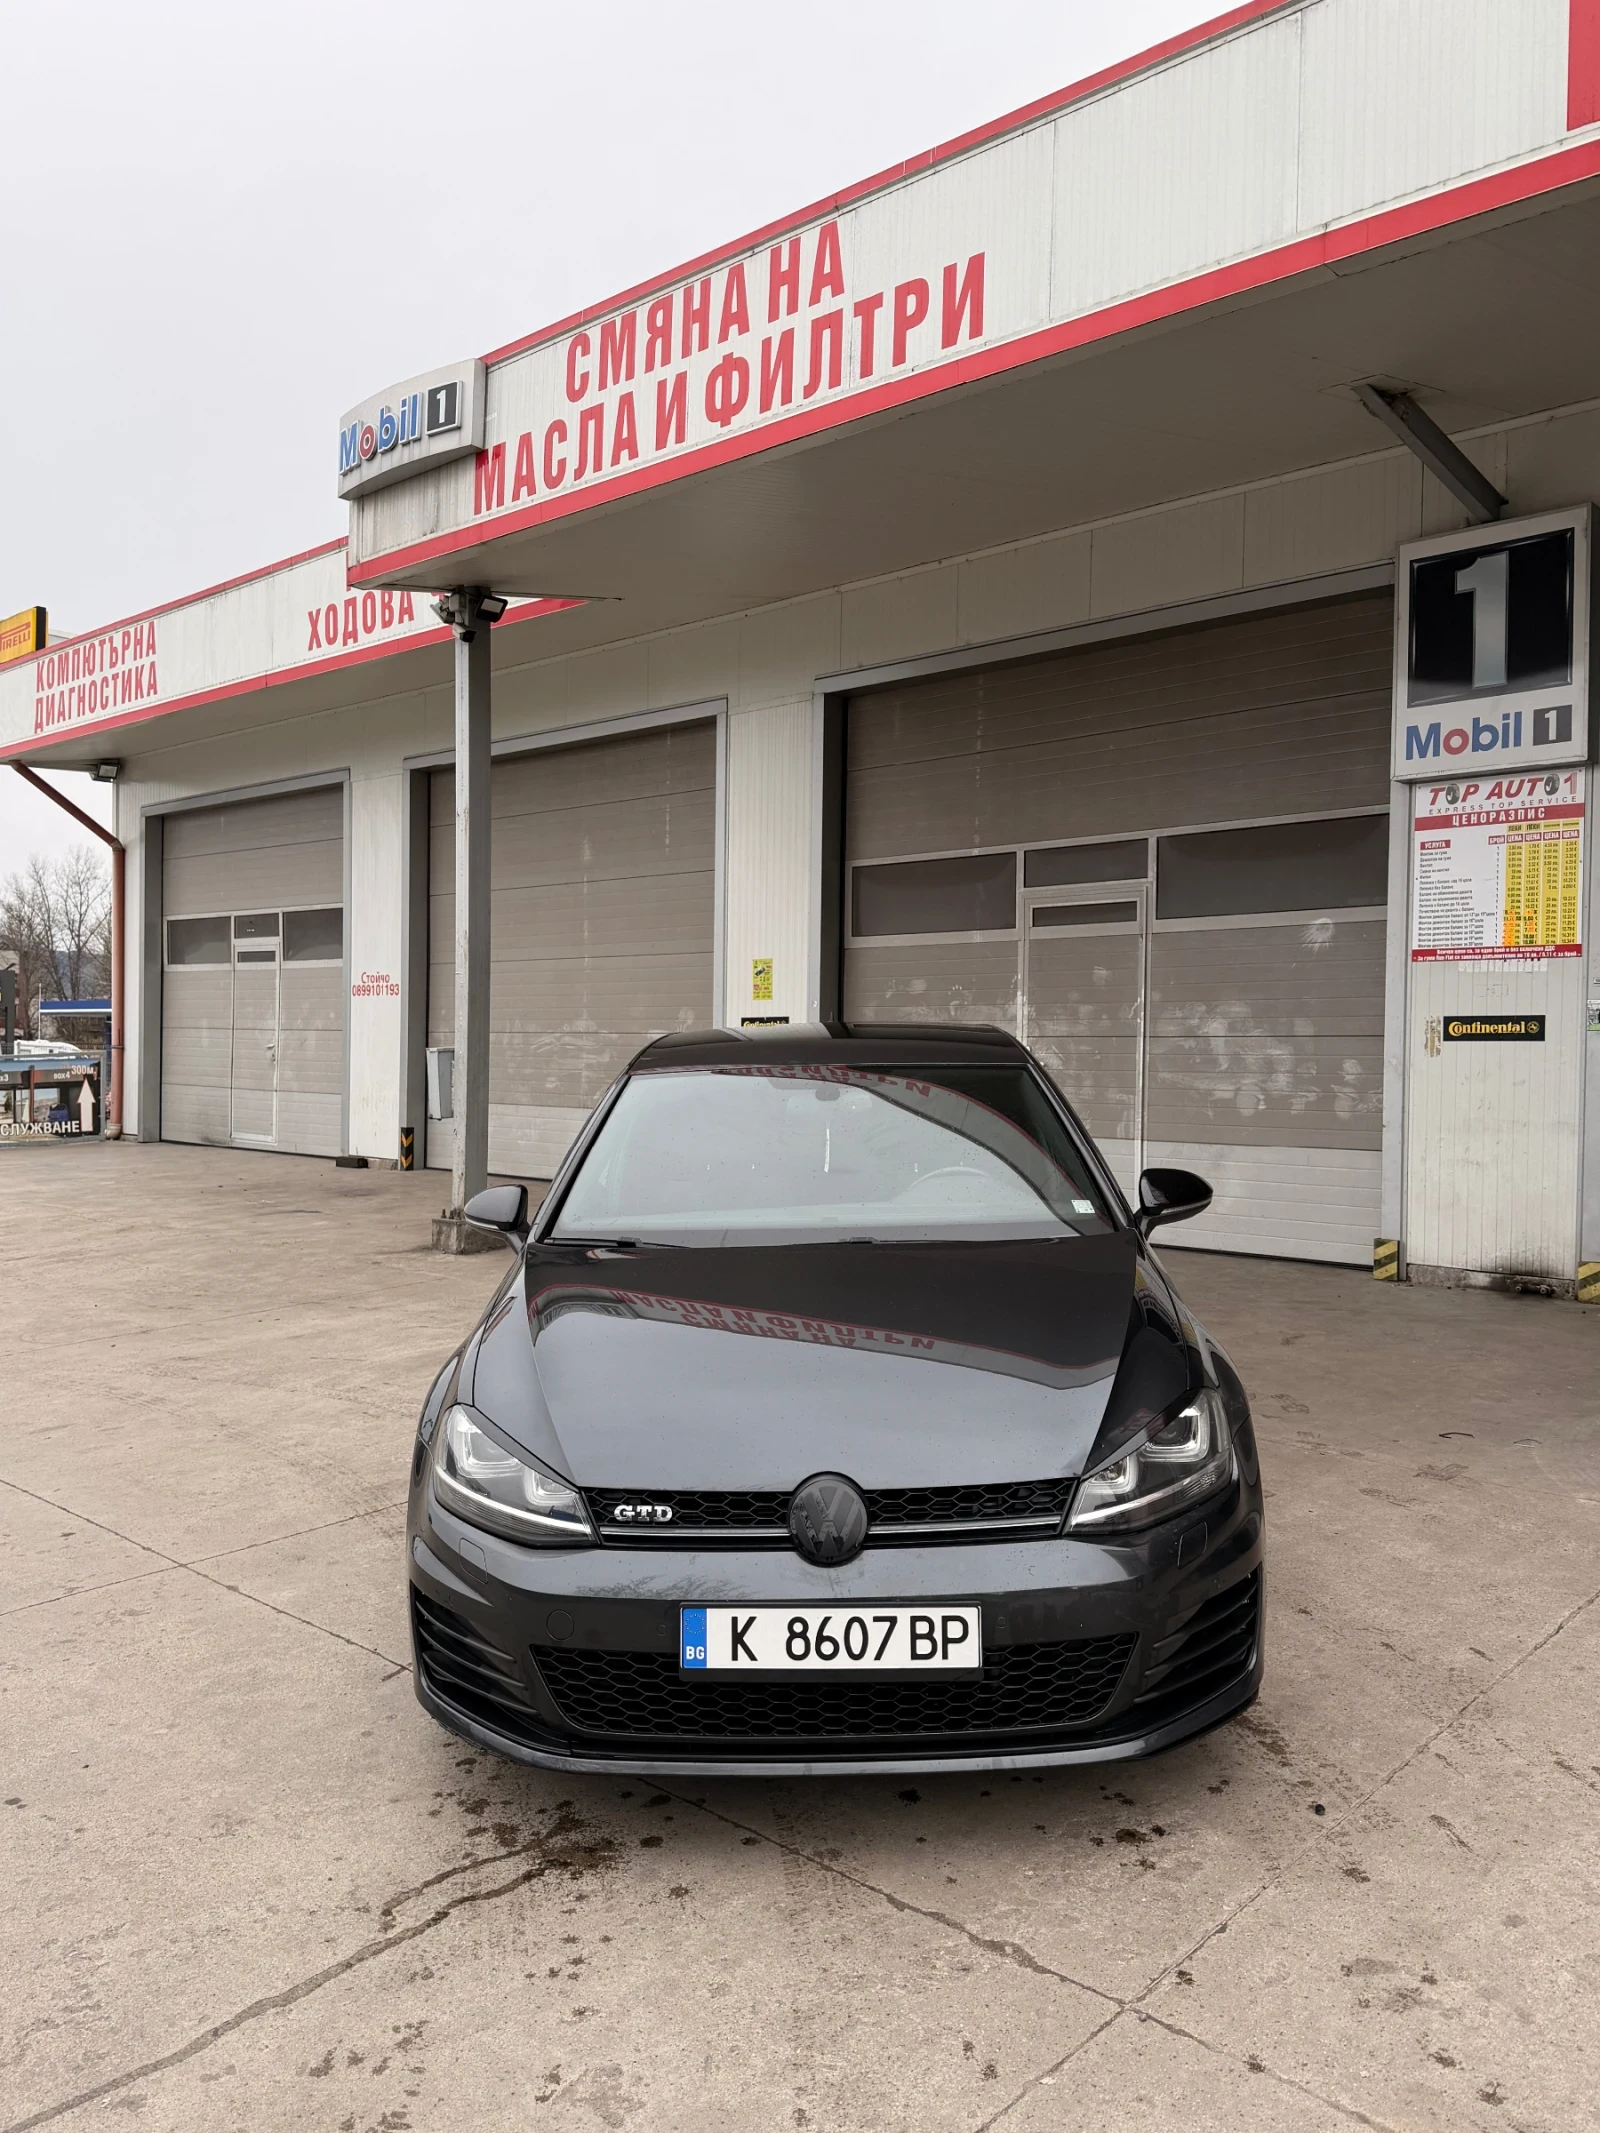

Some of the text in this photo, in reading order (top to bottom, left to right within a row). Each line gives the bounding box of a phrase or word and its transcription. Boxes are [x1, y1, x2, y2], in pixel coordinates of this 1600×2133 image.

[565, 220, 845, 403] СМЯНА НА
[473, 251, 986, 516] МАСЛА И ФИЛТРИ
[340, 391, 422, 475] Mobil
[307, 590, 415, 651] ХОДОВА
[1454, 550, 1509, 690] 1
[36, 620, 157, 694] КОМПЮТЪРНА
[34, 660, 158, 735] ДИАГНОСТИКА
[1405, 711, 1523, 761] Mobil
[1429, 795, 1577, 815] EXPRESS TOP SERVICE
[1452, 807, 1546, 826] ЦЕНОРАЗПИС
[1526, 833, 1541, 841] ЦЕНА
[1563, 830, 1578, 838] ЦЕНА
[1424, 841, 1446, 849] УСЛУГА
[361, 971, 390, 984] Стойчо
[352, 983, 400, 997] 0899101193
[1448, 1021, 1526, 1037] Continental
[0, 1120, 80, 1136] СЛУЖВАНЕ
[613, 1504, 673, 1523] GTD
[730, 1615, 970, 1662] K 8607 BP
[686, 1646, 705, 1661] BG
